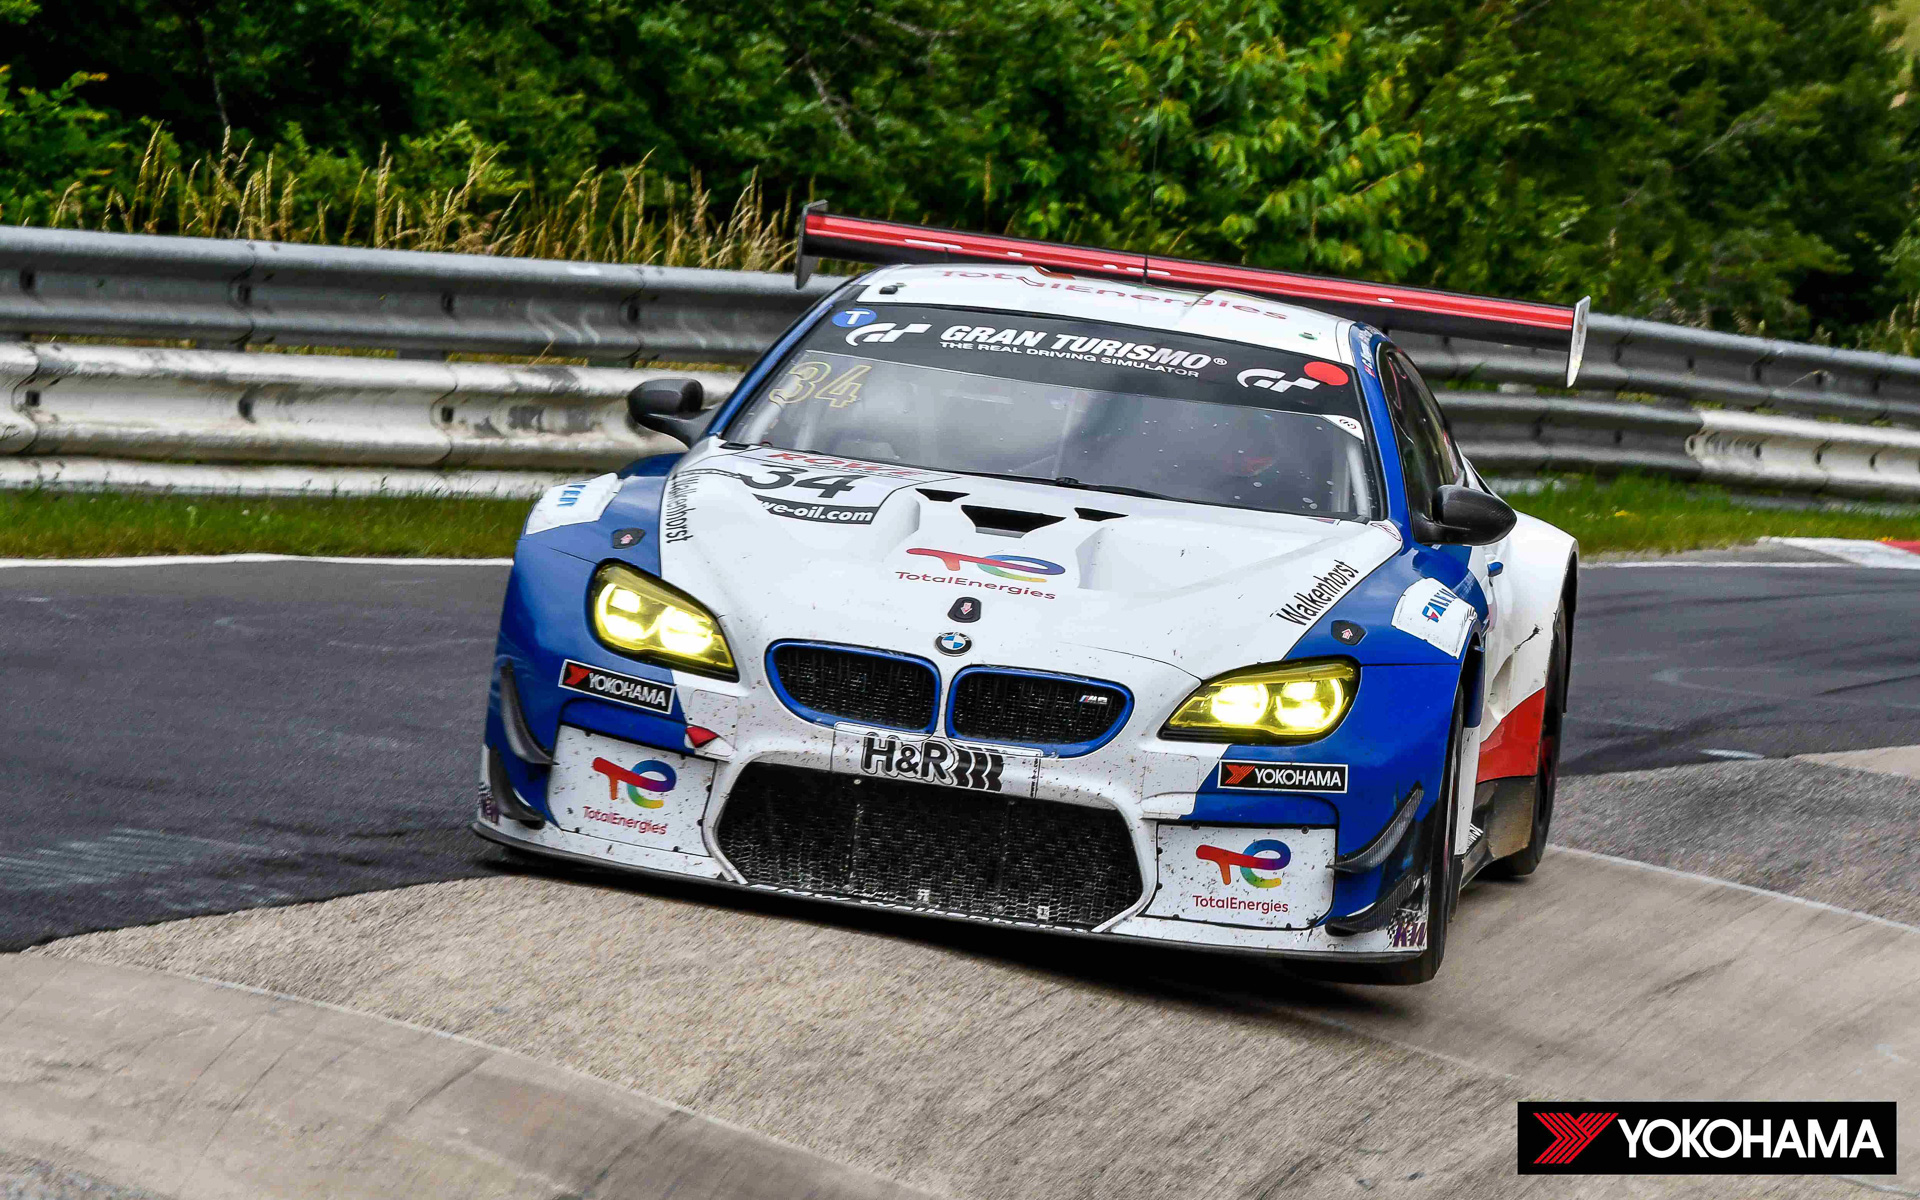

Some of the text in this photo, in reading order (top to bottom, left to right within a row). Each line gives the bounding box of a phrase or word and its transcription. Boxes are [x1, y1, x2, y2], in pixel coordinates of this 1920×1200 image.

[941, 269, 1289, 321] TotalEnergies
[939, 324, 1048, 348] GRAN
[939, 341, 1200, 378] THE REAL DRIVING SIMULATOR
[768, 361, 873, 408] 34
[737, 463, 870, 499] 34
[895, 571, 1056, 600] TotalEnergies
[1275, 559, 1359, 626] Walkenhorst
[588, 672, 667, 707] YOKOHAMA
[863, 733, 952, 783] H&R
[1254, 768, 1342, 787] YOKOHAMA
[582, 805, 669, 835] TotalEnergies
[1192, 895, 1289, 915] TotalEnergies
